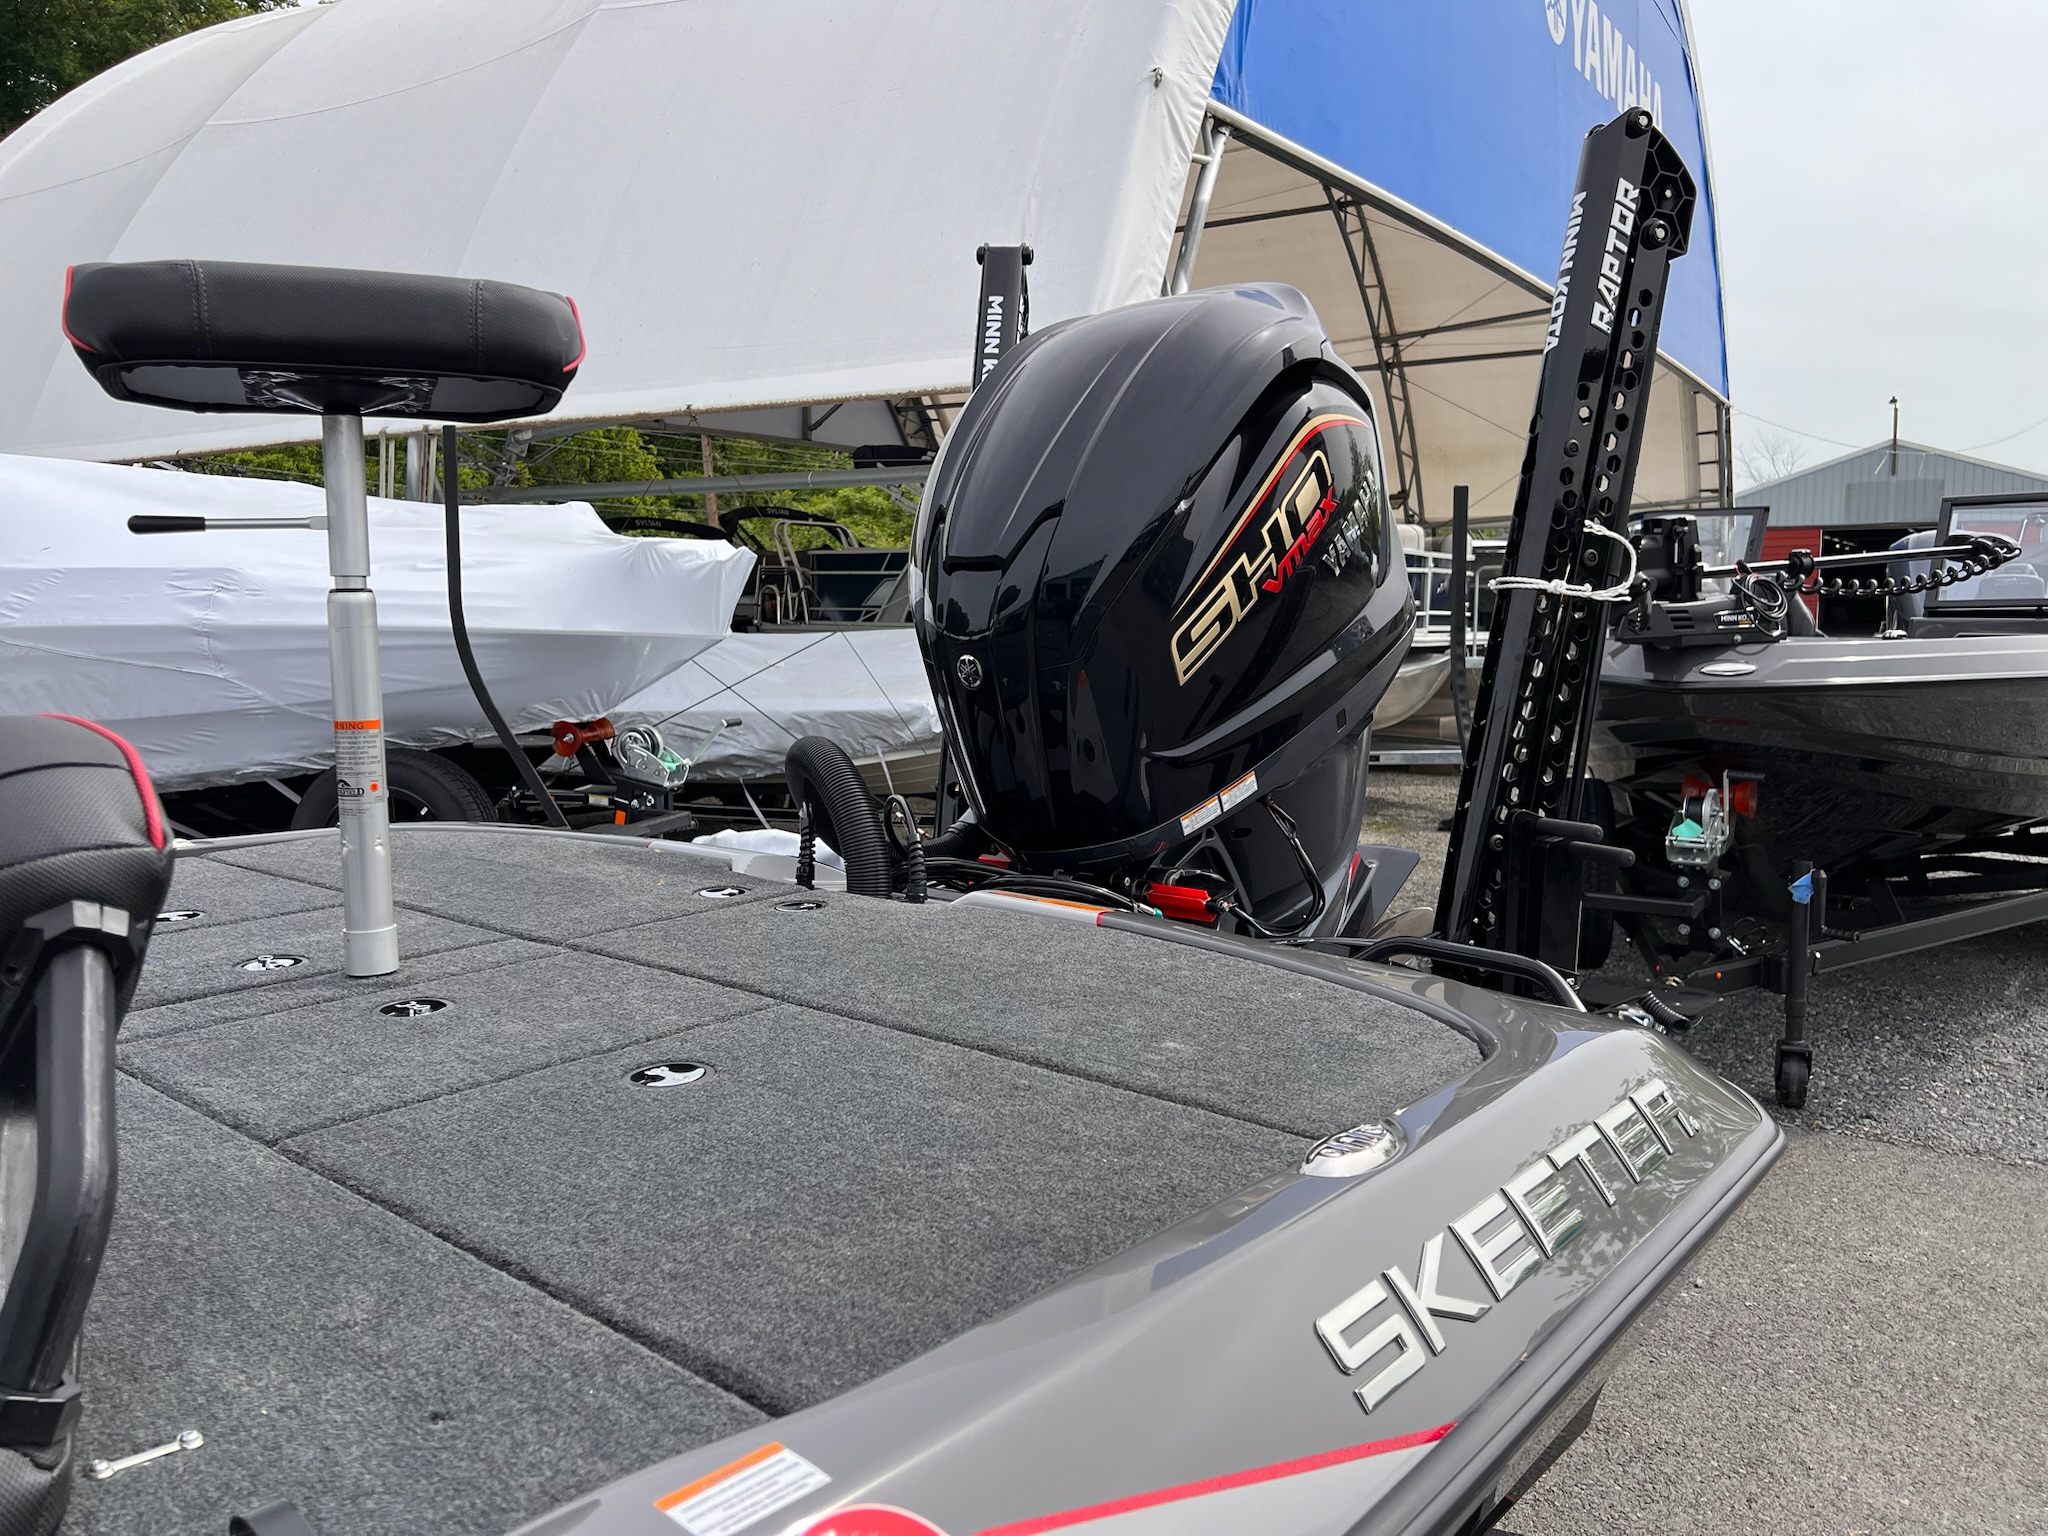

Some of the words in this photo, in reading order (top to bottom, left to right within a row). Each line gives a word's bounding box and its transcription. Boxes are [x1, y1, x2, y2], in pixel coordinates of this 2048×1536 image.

[1559, 191, 1588, 270] MINN
[1590, 177, 1640, 334] RAPTOR
[983, 295, 1005, 354] MINN
[1543, 276, 1571, 355] KOTA
[1170, 450, 1333, 687] SHO
[1314, 1077, 1695, 1415] SKEETER
